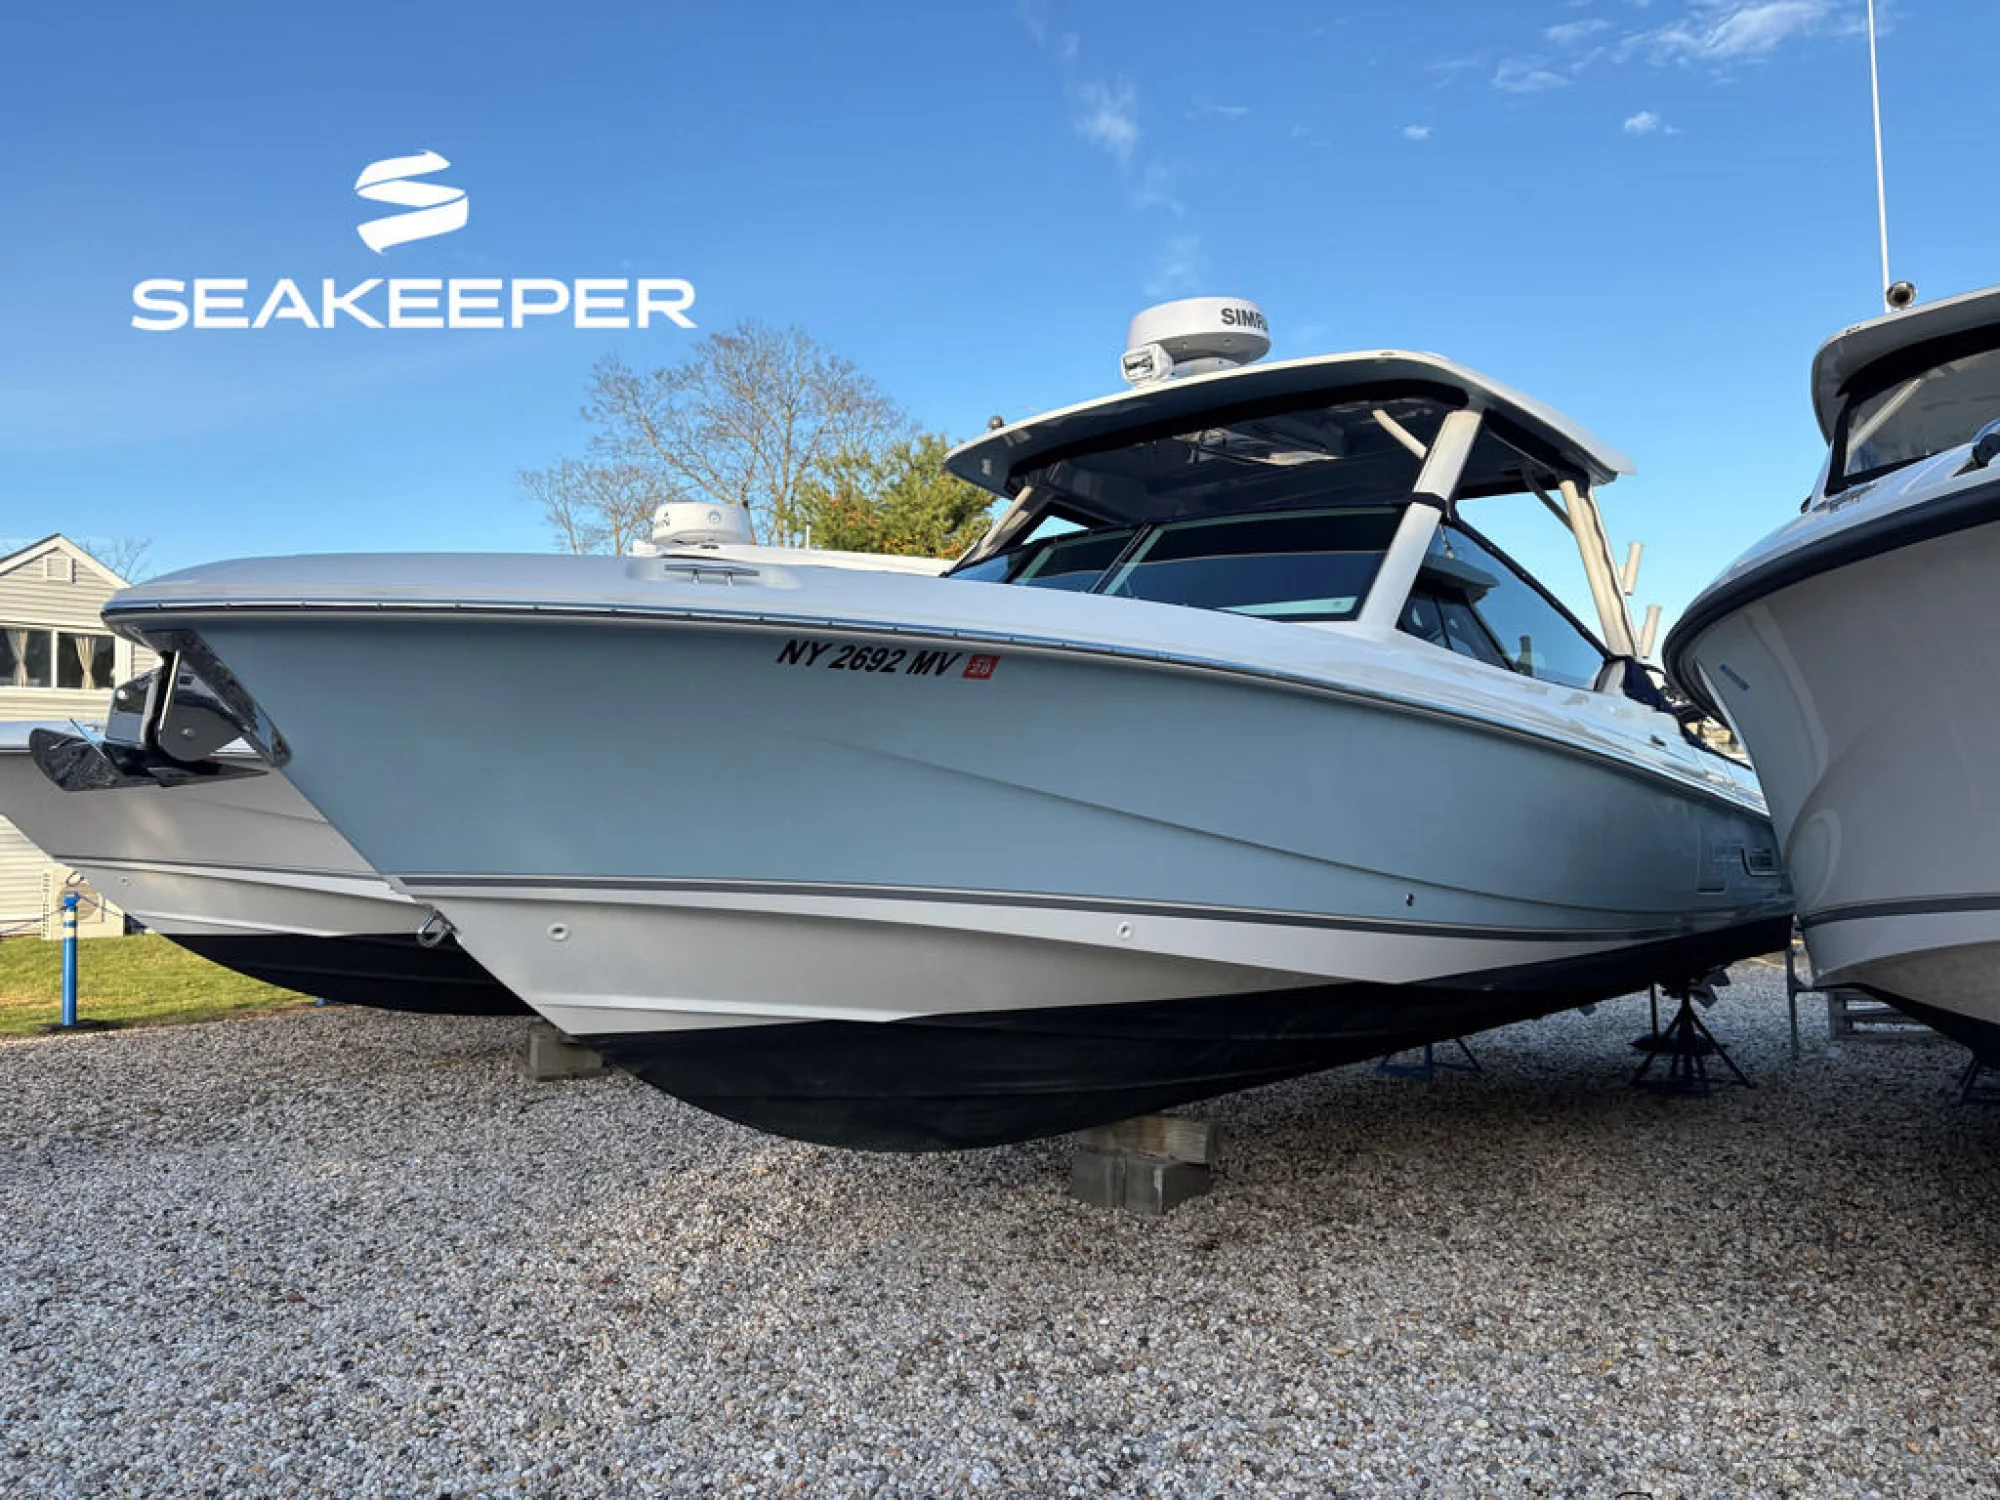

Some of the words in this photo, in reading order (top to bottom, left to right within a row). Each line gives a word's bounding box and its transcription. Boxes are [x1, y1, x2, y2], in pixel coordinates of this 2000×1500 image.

[776, 639, 834, 666] NY
[828, 644, 907, 673] 2692
[905, 650, 963, 676] MV
